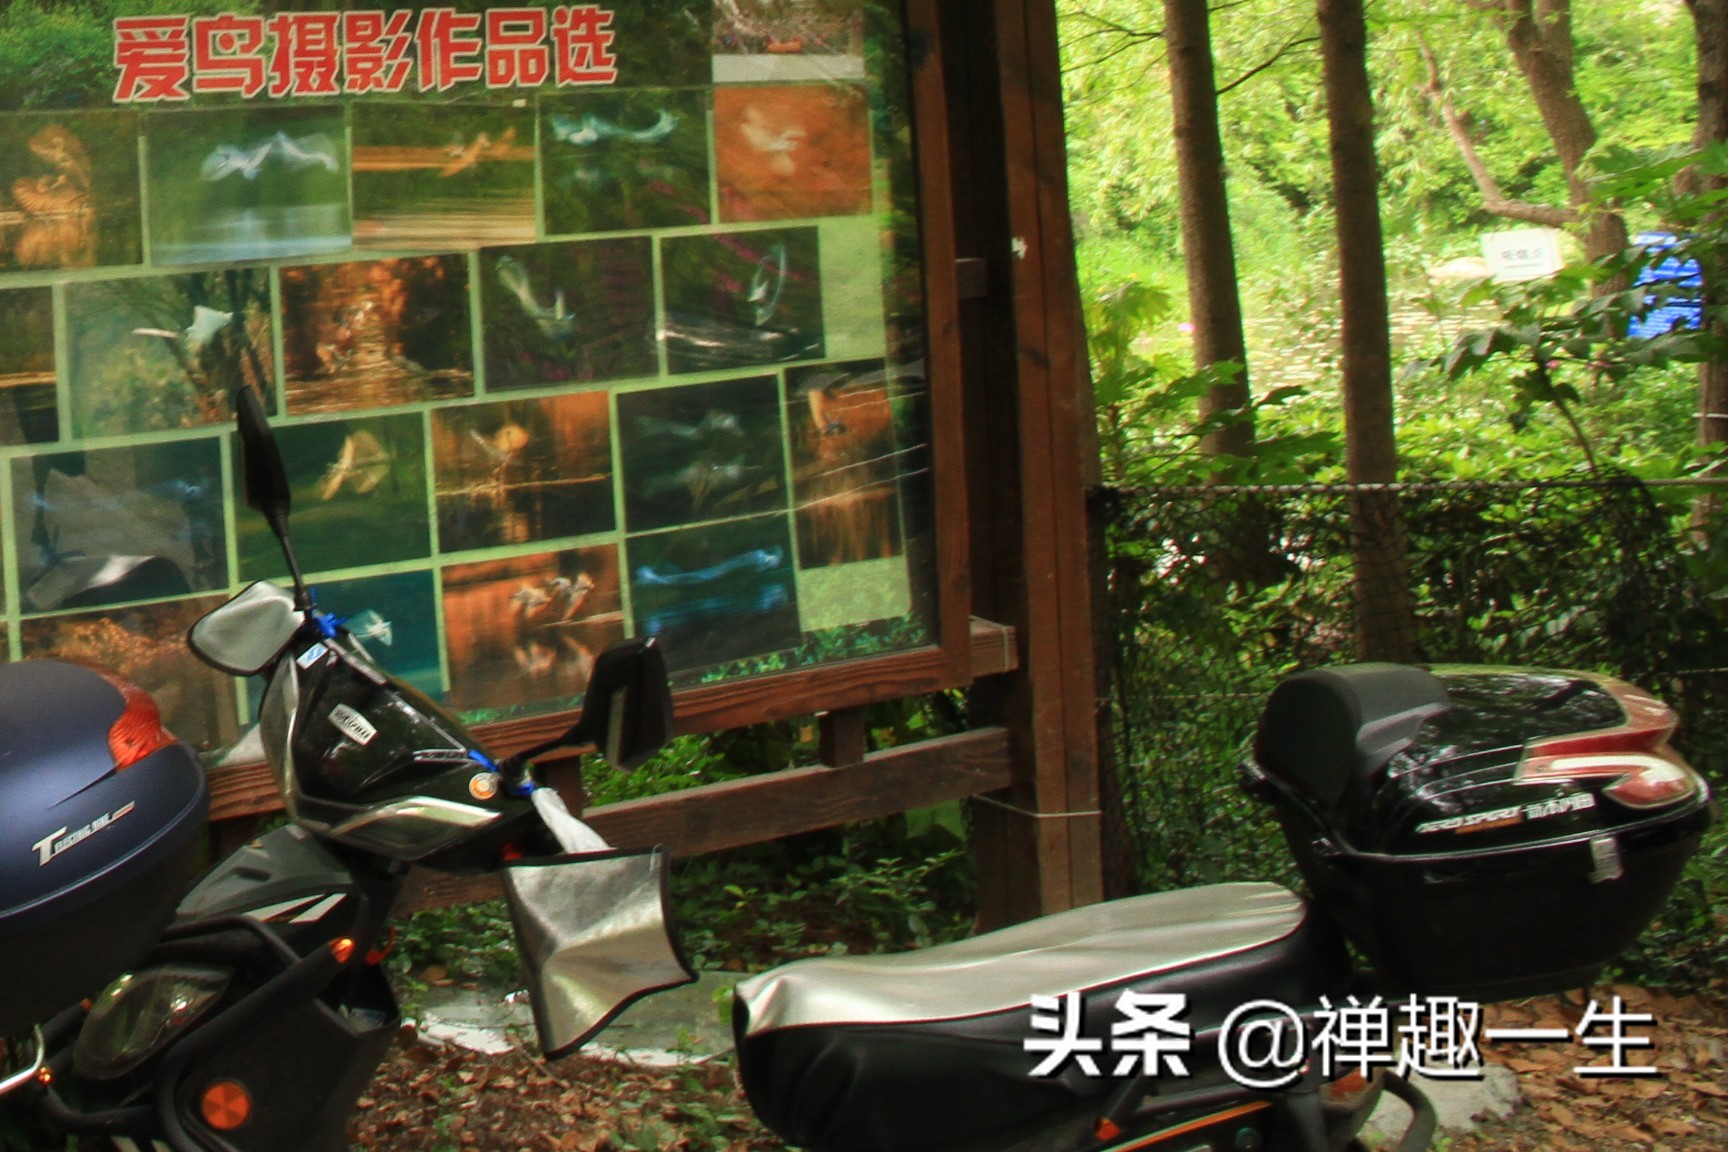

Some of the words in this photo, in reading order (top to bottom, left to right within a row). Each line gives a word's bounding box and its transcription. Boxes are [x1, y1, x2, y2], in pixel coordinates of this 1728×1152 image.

[112, 4, 618, 103] 爱鸟摄影作品选
